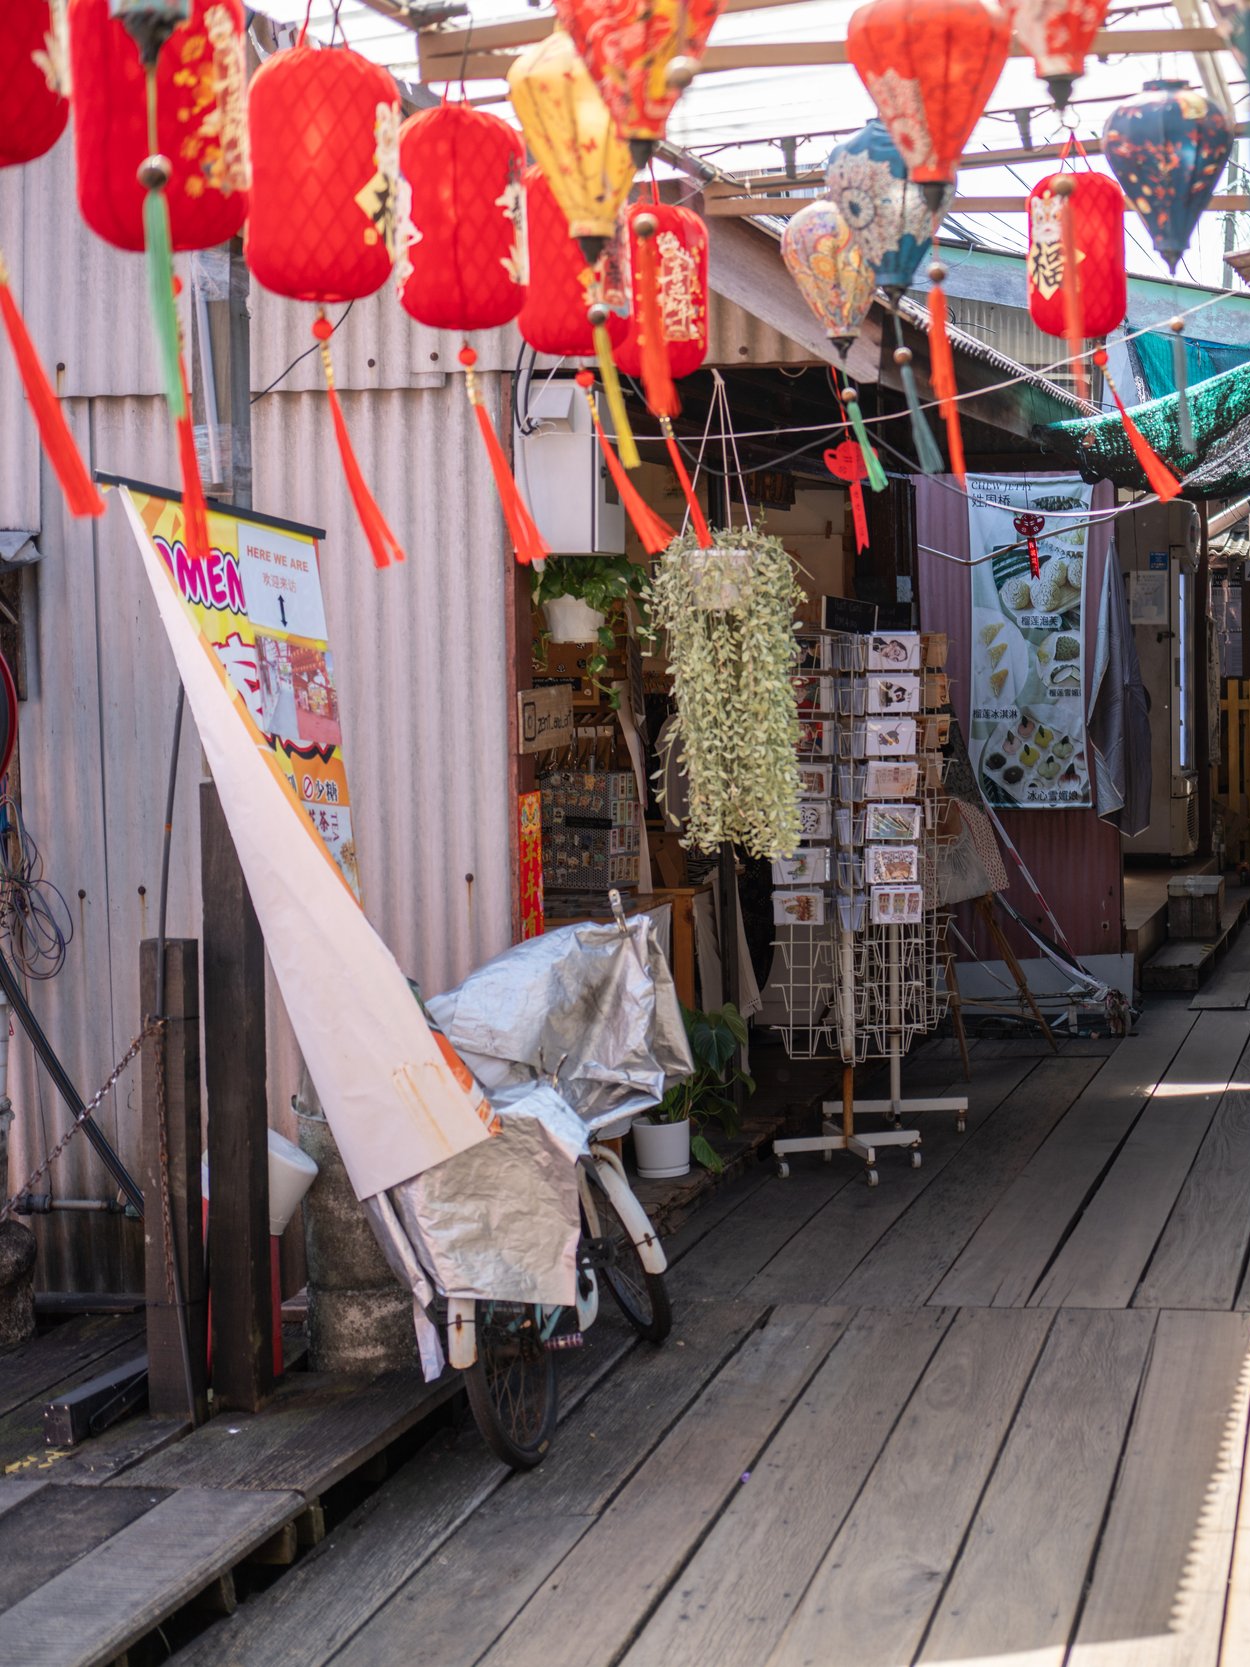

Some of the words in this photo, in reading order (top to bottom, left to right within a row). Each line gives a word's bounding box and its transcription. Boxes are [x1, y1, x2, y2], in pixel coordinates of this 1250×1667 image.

[971, 481, 1003, 490] CHEW
[1003, 481, 1033, 492] JETTY
[246, 545, 271, 562] HERE
[273, 552, 288, 567] WE
[290, 558, 309, 573] ARE
[262, 572, 297, 594] 欢迎来访
